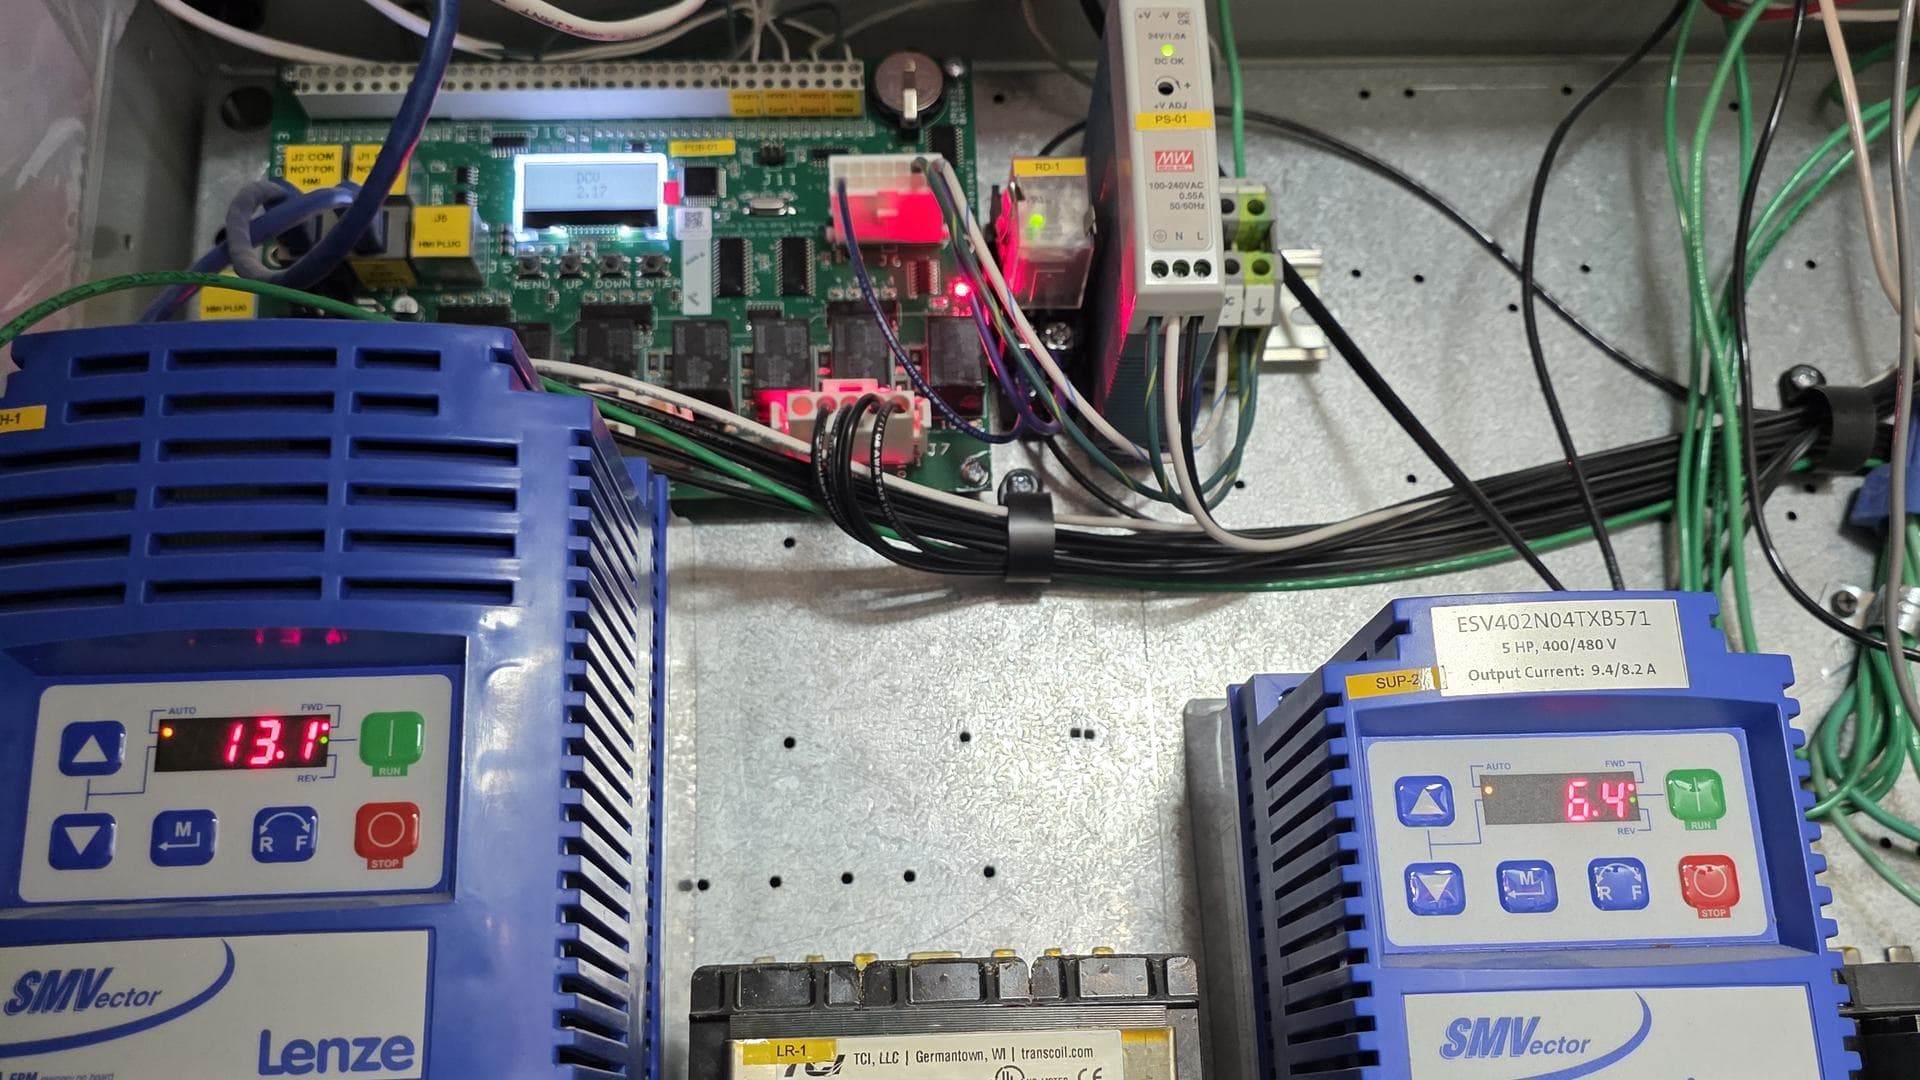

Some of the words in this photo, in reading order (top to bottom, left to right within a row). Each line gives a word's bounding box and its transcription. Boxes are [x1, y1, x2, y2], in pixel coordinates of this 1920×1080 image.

[1155, 115, 1188, 125] PS-01
[307, 152, 335, 162] COM
[1156, 151, 1192, 165] MW
[290, 164, 312, 174] NOT
[314, 164, 335, 174] FOR
[1034, 162, 1061, 172] RD-1
[302, 177, 321, 186] HMI
[1149, 181, 1204, 190] 100-240VAC
[576, 186, 608, 200] 2.17
[1179, 192, 1205, 200] 0.55A
[1169, 202, 1205, 211] 50/60Hz
[1175, 231, 1184, 240] N
[1197, 231, 1204, 240] L
[436, 240, 462, 249] PLUG
[514, 279, 550, 289] MENU
[565, 279, 584, 289] UP
[595, 279, 632, 289] DOWN
[636, 279, 682, 289] ENTER
[1457, 610, 1652, 633] ESV402N04TXB571
[1502, 642, 1510, 654] 5
[1515, 641, 1539, 655] HP,
[1542, 637, 1604, 654] 400/480
[1606, 638, 1617, 650] V
[1468, 667, 1521, 684] Output
[1524, 664, 1585, 679] Current:
[1591, 661, 1643, 678] 9.4/8.2
[1646, 663, 1657, 676] A
[1375, 673, 1419, 690] SUP-2
[168, 706, 197, 715] AUTO
[301, 703, 324, 711] FWD
[226, 718, 320, 765] 13.1
[1485, 762, 1512, 771] AUTO
[1604, 760, 1626, 768] FWD
[378, 766, 402, 776] RUN
[297, 774, 318, 783] REV
[1567, 781, 1626, 821] 6.4
[175, 821, 192, 837] M
[1690, 821, 1712, 831] RUN
[1617, 827, 1636, 836] REV
[259, 837, 273, 853] R
[296, 836, 308, 852] F
[370, 857, 400, 870] STOP
[1520, 872, 1535, 886] M
[1599, 886, 1613, 901] R
[1631, 886, 1642, 900] F
[1701, 908, 1727, 918] STOP
[257, 1028, 416, 1077] Lenze
[776, 1044, 807, 1057] LR-1
[854, 1051, 876, 1067] TCI,
[879, 1051, 900, 1064] LLC
[916, 1049, 988, 1064] Germantown,
[991, 1047, 1006, 1061] WI
[1021, 1045, 1094, 1060] transcoil.com
